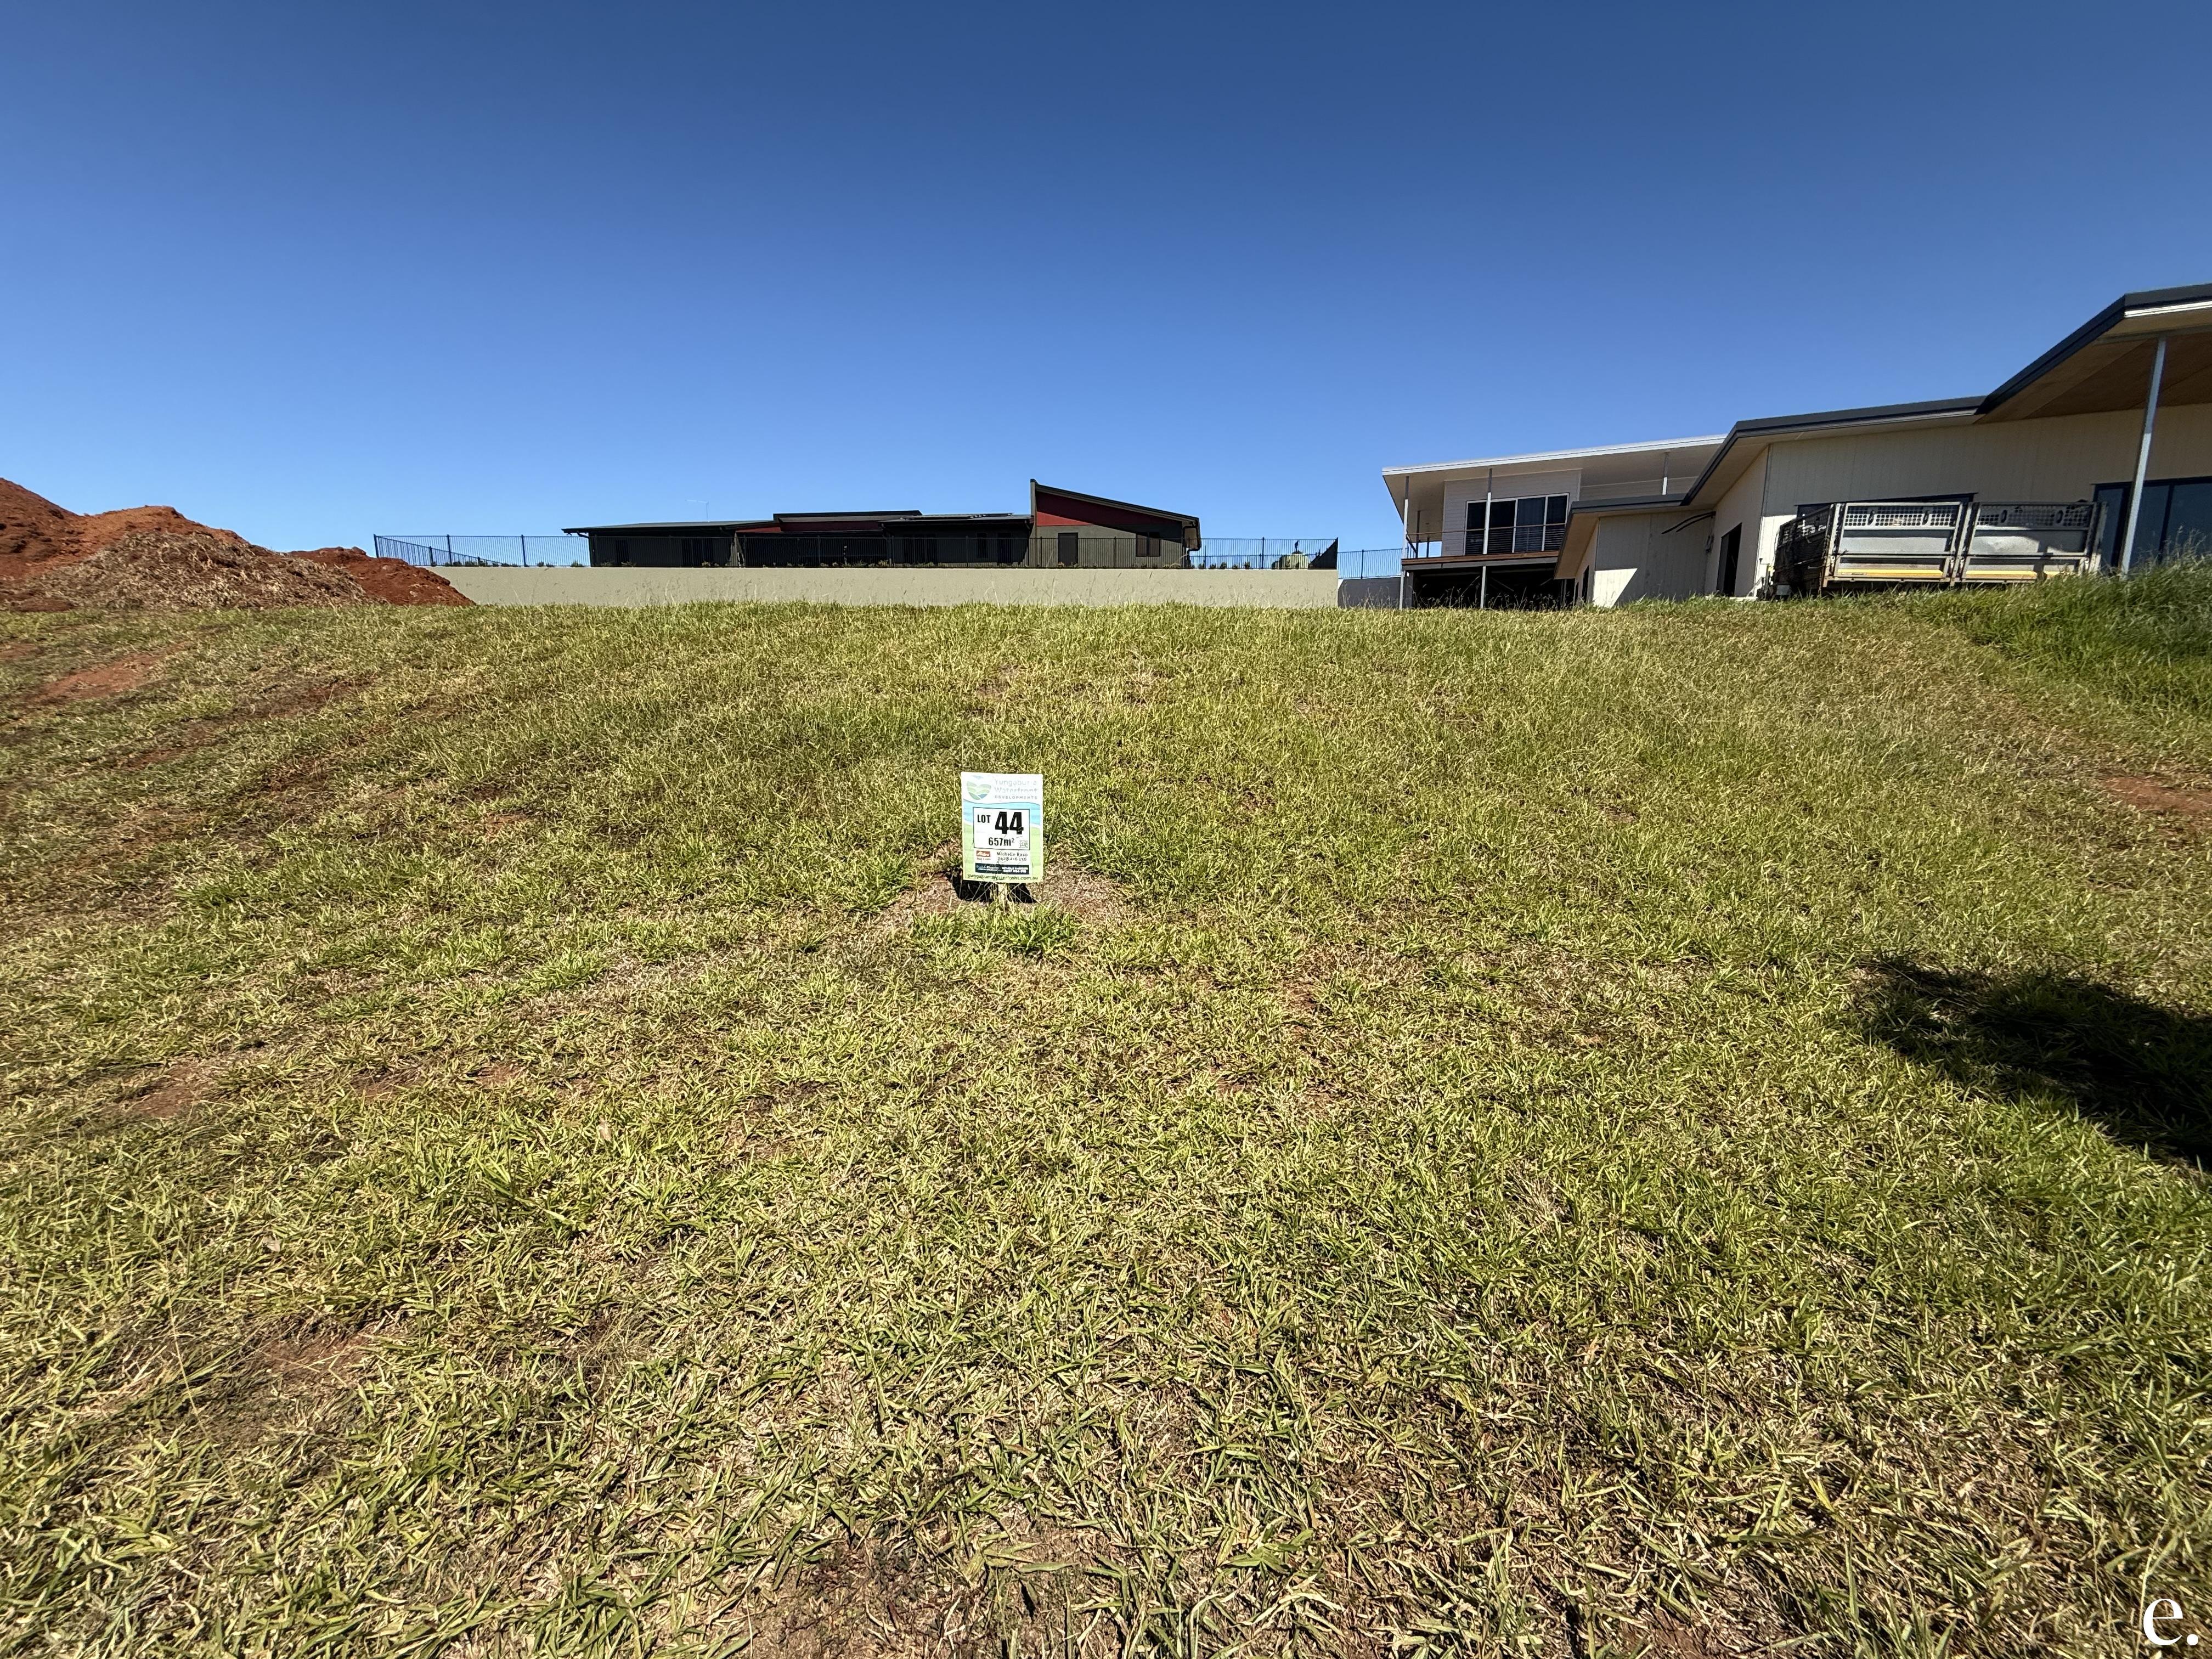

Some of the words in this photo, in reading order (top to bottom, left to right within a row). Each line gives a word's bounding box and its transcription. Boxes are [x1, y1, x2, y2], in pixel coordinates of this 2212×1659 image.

[994, 778, 1037, 787] Yungabura
[977, 814, 991, 823] LOT
[995, 811, 1024, 834] 44
